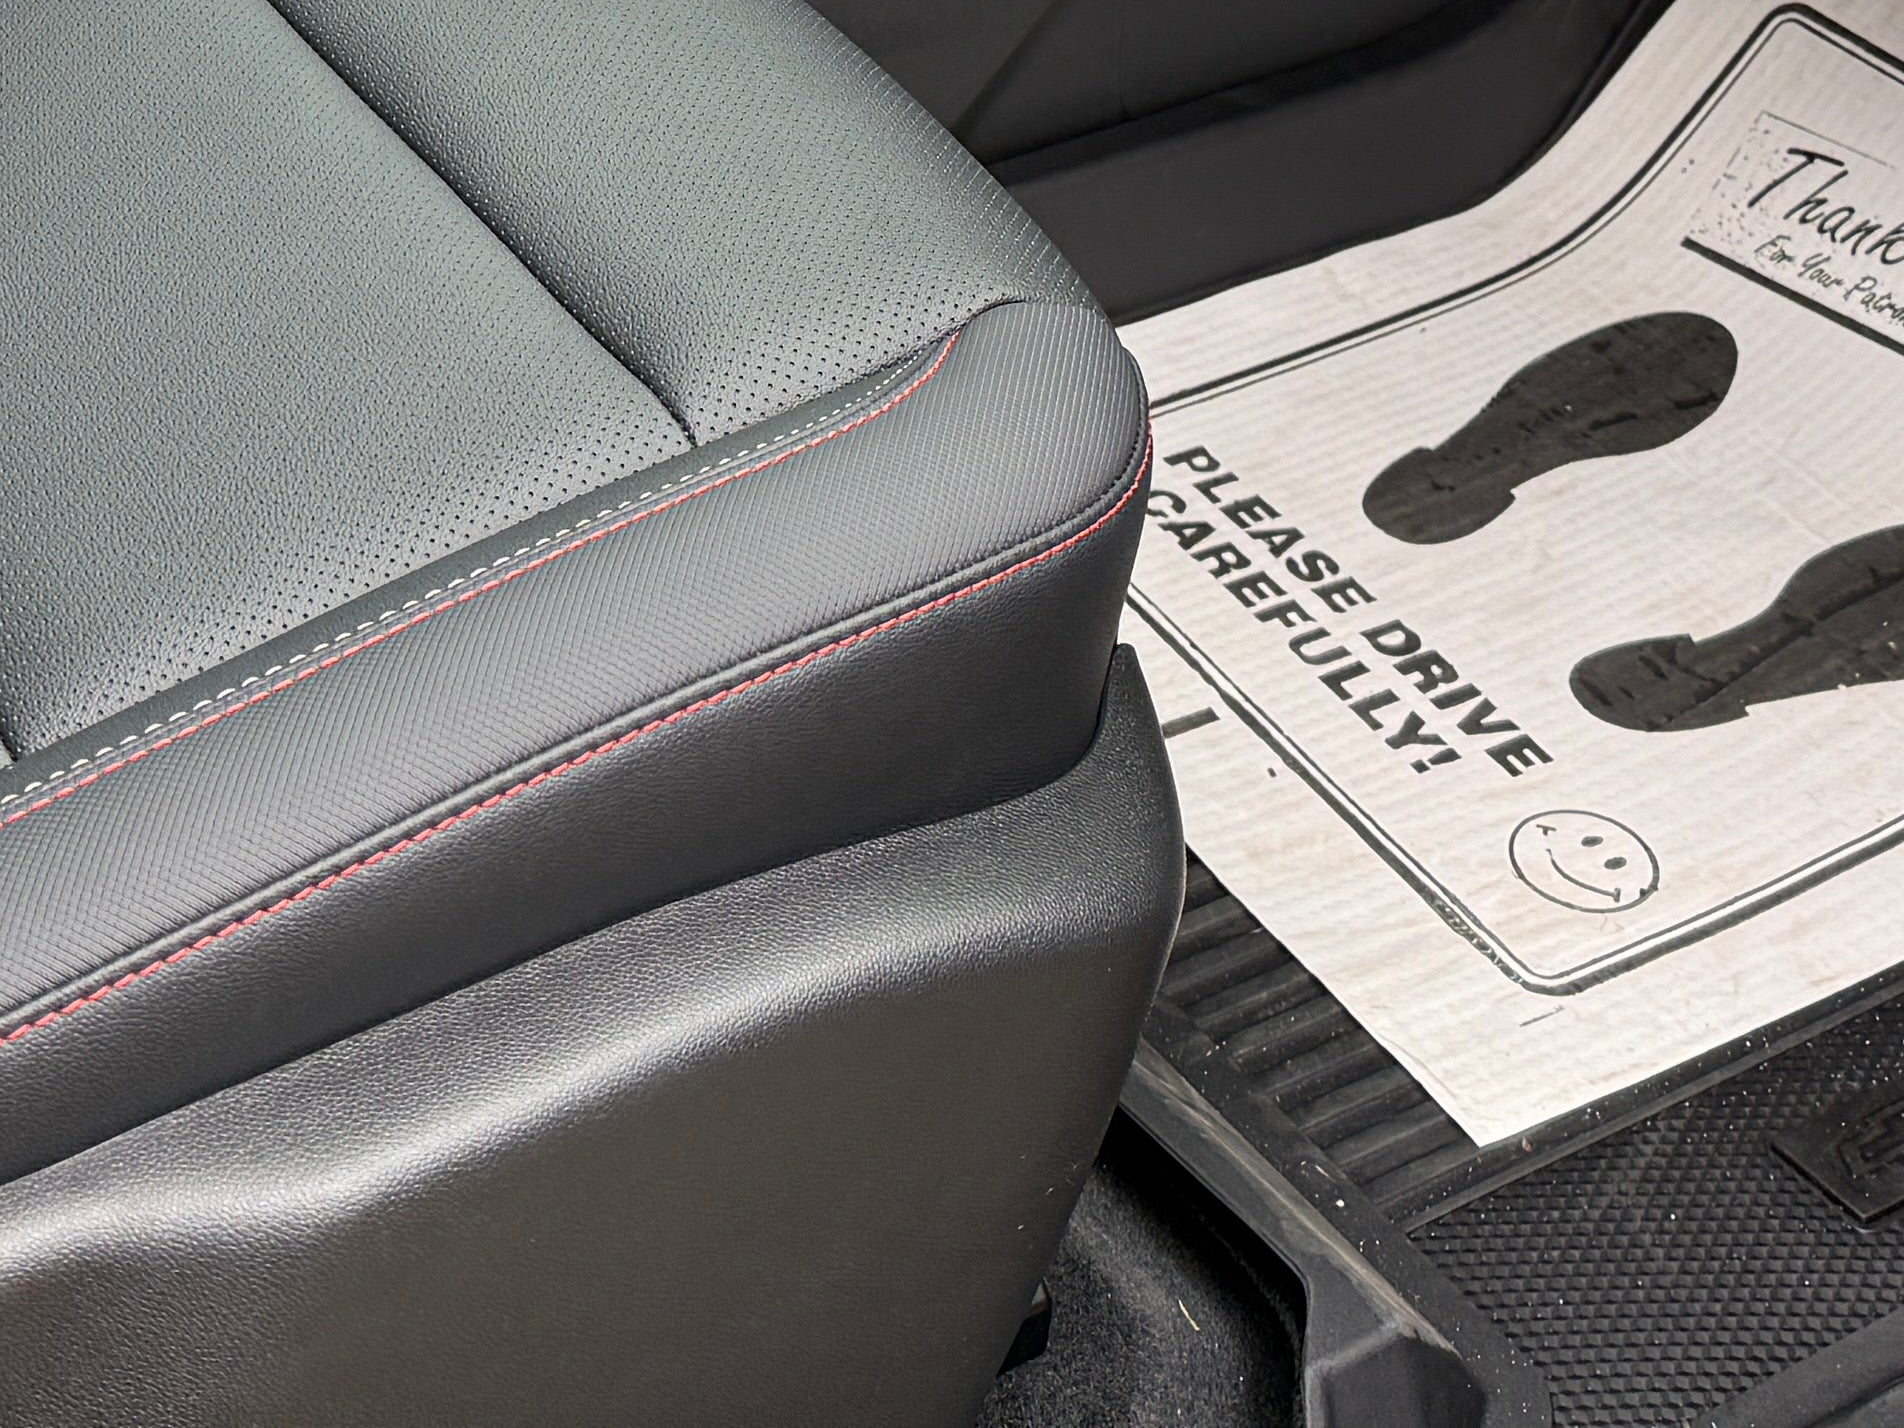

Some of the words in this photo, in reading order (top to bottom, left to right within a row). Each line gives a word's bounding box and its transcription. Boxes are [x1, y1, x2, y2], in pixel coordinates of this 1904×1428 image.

[1754, 235, 1797, 265] For
[1802, 252, 1844, 289] Your
[1145, 488, 1463, 774] CAREFULLY!
[1163, 445, 1377, 614] PLEASE
[1359, 619, 1555, 778] DRIVE
